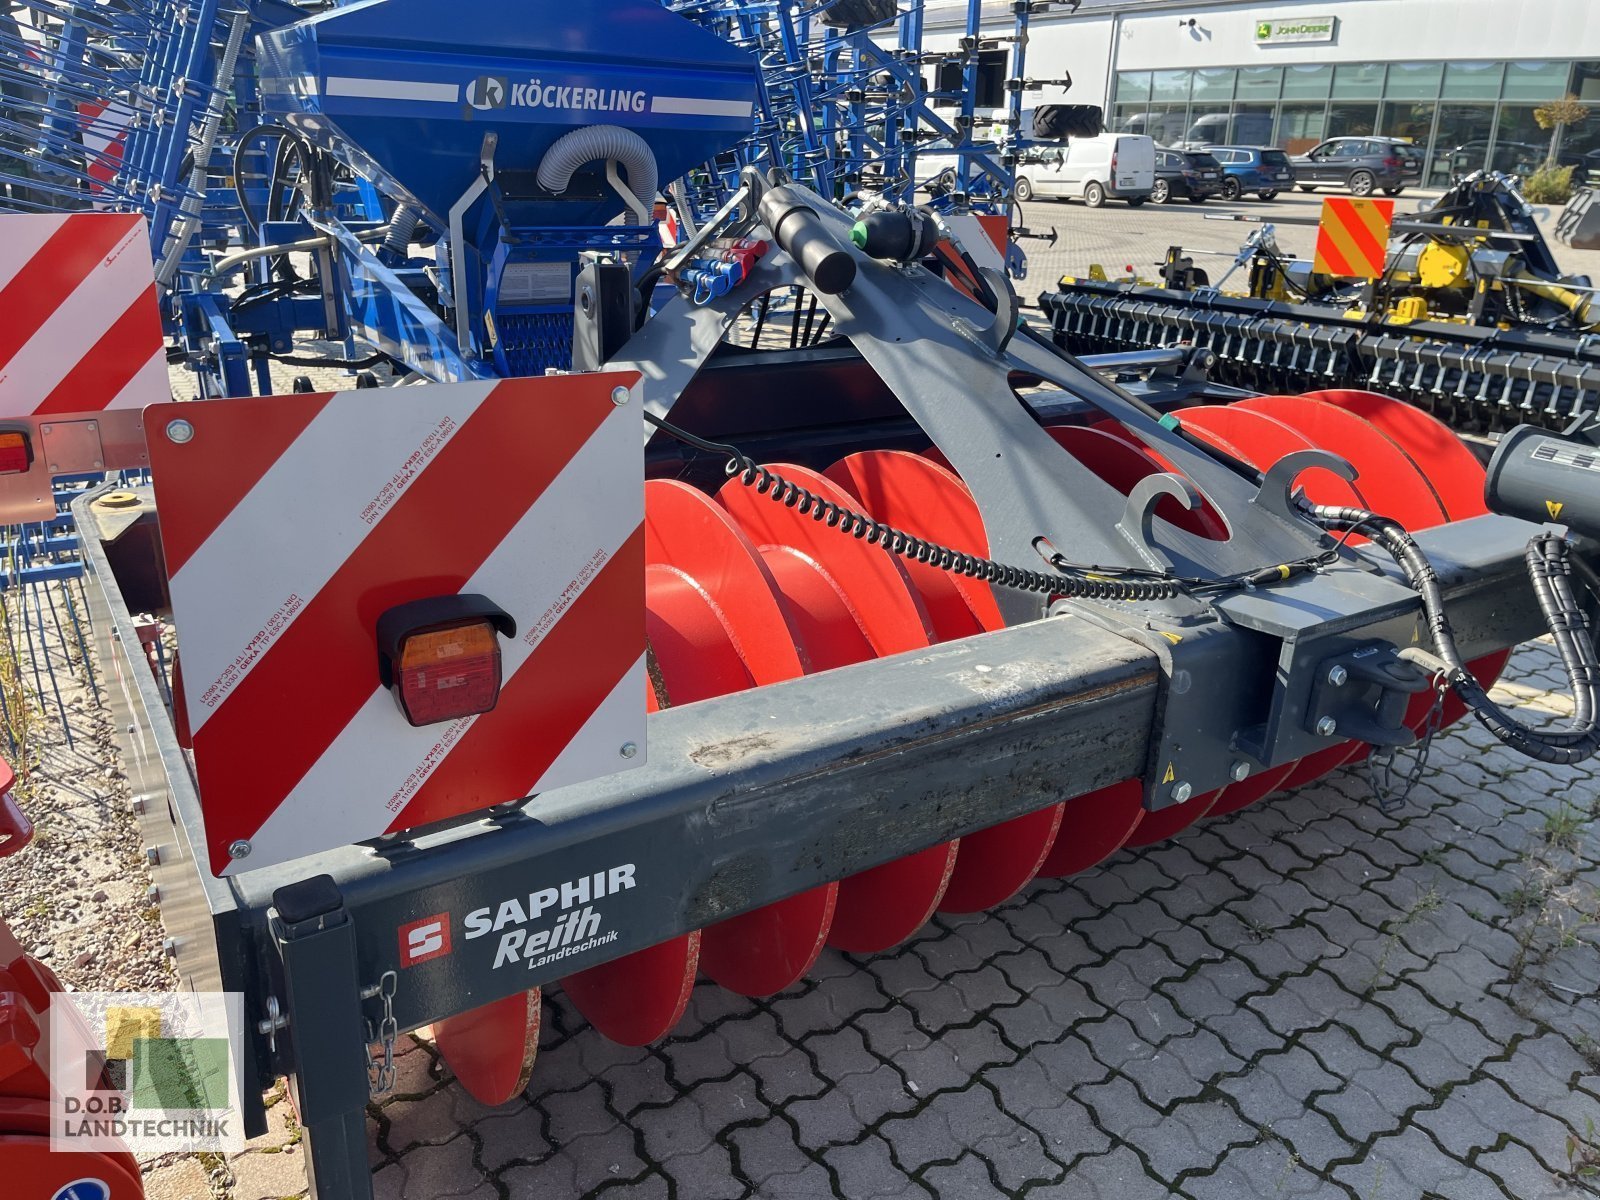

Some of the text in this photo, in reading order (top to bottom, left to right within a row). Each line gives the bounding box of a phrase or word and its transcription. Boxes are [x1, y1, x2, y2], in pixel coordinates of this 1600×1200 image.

[1276, 26, 1300, 35] JOHN
[510, 78, 646, 112] KÖCKERLING
[439, 416, 450, 429] DIN
[423, 430, 439, 448] 11030
[402, 451, 420, 470] GEKA
[366, 512, 379, 524] DIN
[378, 492, 395, 511] 11030
[397, 470, 415, 489] GEKA
[416, 457, 425, 466] TP
[440, 421, 457, 439] 06021
[393, 474, 401, 483] TP
[284, 594, 297, 607] DIN
[267, 608, 286, 627] 11030
[529, 634, 539, 646] DIN
[539, 617, 554, 633] 11030
[556, 597, 572, 614] GEKA
[573, 585, 580, 593] TP
[245, 631, 265, 651] GEKA
[207, 694, 221, 707] DIN
[220, 674, 238, 693] 11030
[240, 650, 260, 670] GEKA
[261, 636, 270, 646] TP
[286, 598, 304, 617] 06021
[236, 656, 244, 665] TP
[391, 800, 403, 812] DIN
[402, 782, 417, 799] 11030
[420, 760, 436, 778] GEKA
[437, 747, 445, 756] TP
[460, 717, 472, 730] 0602
[464, 864, 636, 940] SAPHIR
[492, 906, 602, 970] Reith
[528, 930, 618, 970] Landtechnik
